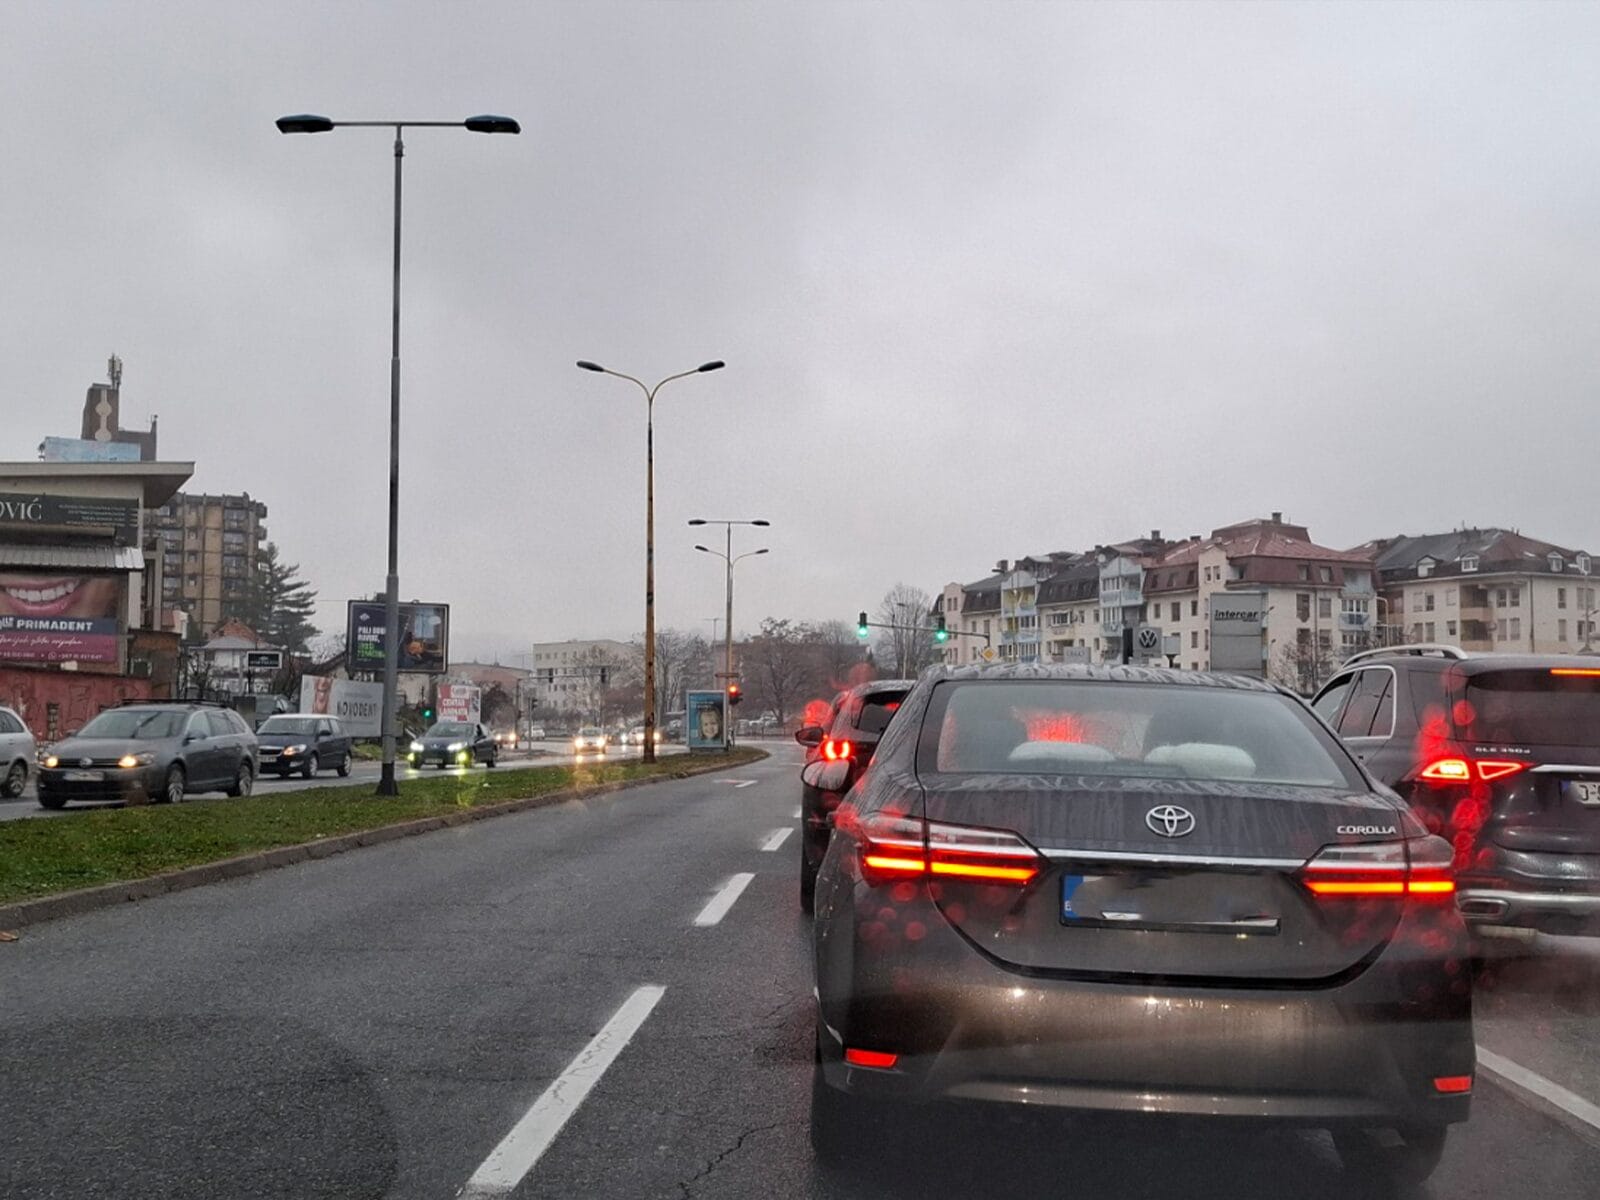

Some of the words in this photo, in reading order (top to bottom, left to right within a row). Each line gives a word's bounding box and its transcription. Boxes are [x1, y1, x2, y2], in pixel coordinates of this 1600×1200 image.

[16, 619, 94, 631] PRIMADENT
[336, 701, 377, 717] NOVODENT
[1336, 825, 1397, 836] COROLLA
